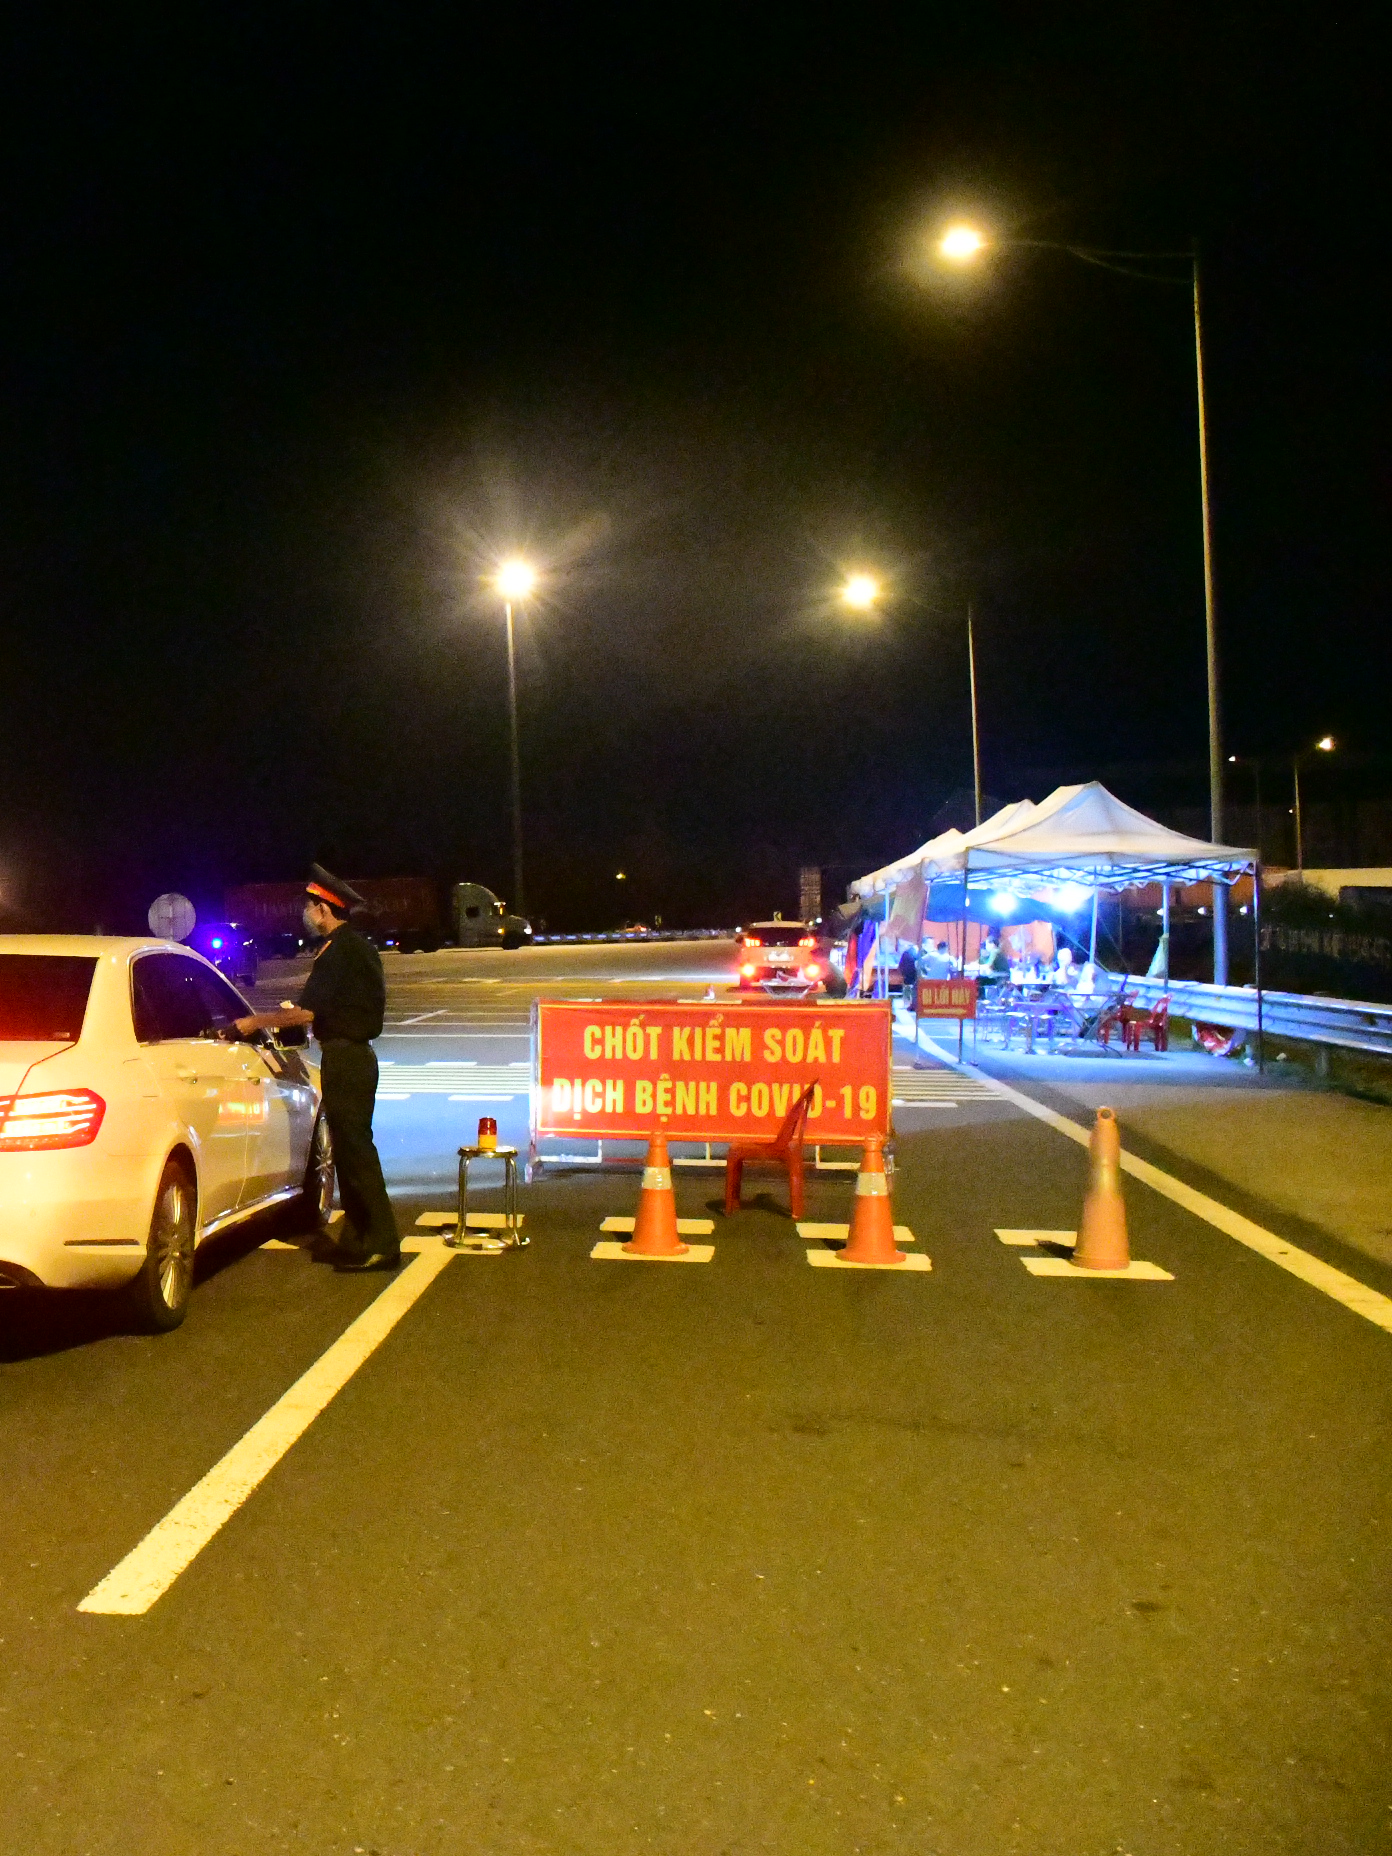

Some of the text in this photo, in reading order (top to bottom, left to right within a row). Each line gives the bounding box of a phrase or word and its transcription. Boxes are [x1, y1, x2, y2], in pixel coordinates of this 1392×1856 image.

[583, 1012, 846, 1064] CHỐT KIỂM SOÁT
[551, 1077, 625, 1121] DỊCH
[634, 1073, 718, 1123] BỆNH
